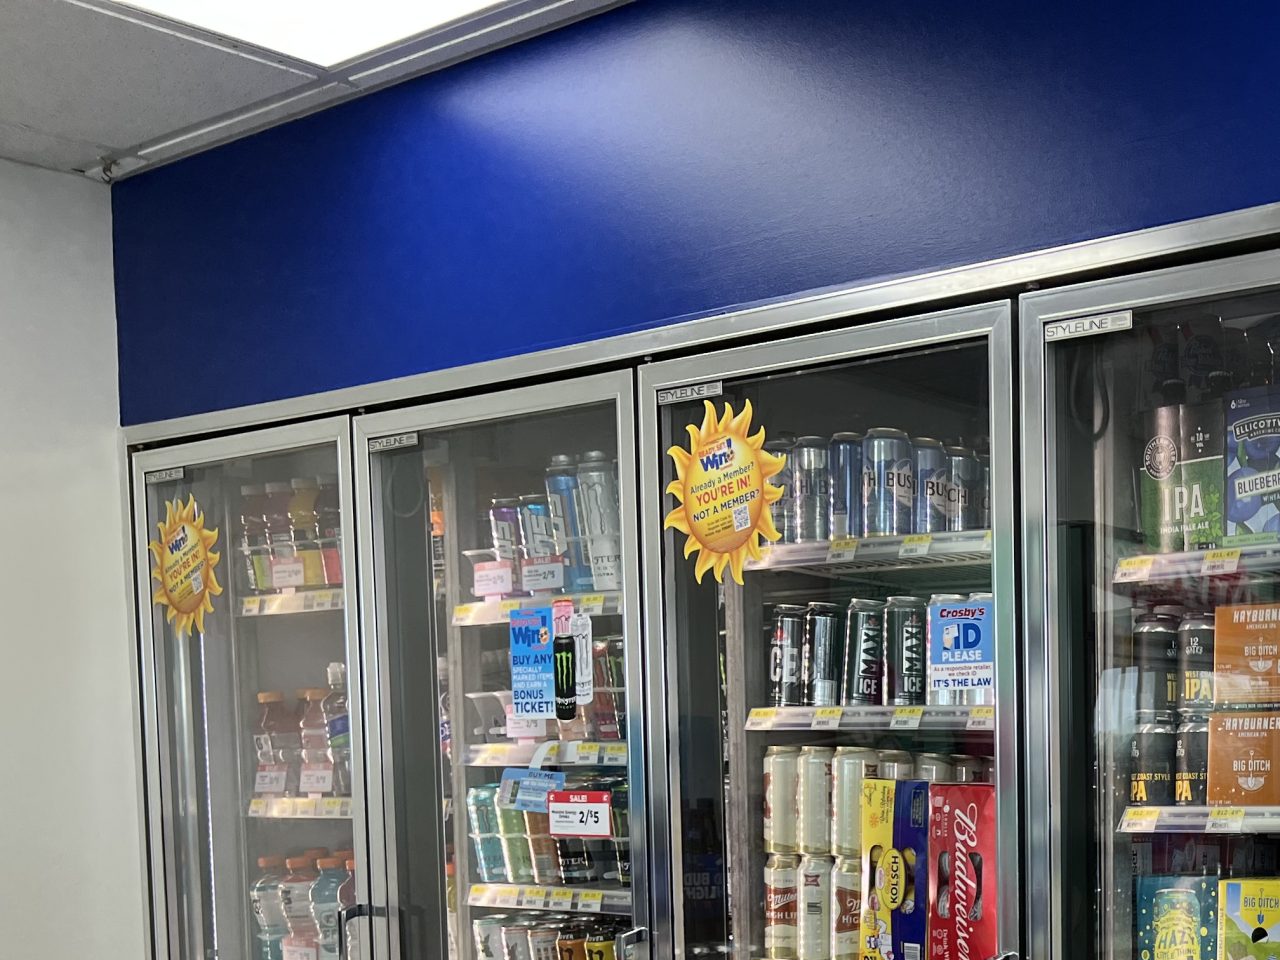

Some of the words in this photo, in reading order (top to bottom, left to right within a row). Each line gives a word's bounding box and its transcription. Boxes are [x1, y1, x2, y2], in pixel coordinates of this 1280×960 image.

[1046, 318, 1109, 337] STYLELINE
[659, 385, 704, 403] STYLELINE
[690, 480, 715, 495] Already
[723, 462, 755, 481] Member?
[696, 482, 734, 506] YOU'RE
[737, 476, 750, 491] IN!
[693, 510, 709, 522] NOT
[712, 506, 719, 514] A
[721, 489, 760, 512] MEMBER?
[1163, 484, 1205, 522] IPA
[939, 607, 985, 619] Crosby's
[861, 629, 880, 675] MAX
[904, 627, 922, 673] MAX
[942, 650, 982, 662] PLEASE
[1244, 646, 1257, 656] BIG
[1258, 645, 1278, 656] DITCH
[512, 655, 531, 665] BUY
[534, 654, 552, 664] ANY
[859, 677, 878, 695] ICE
[904, 676, 922, 693] ICE
[933, 678, 949, 688] IT'S
[951, 678, 969, 687] THE
[971, 677, 992, 686] LAW
[514, 690, 544, 699] BONUS
[514, 702, 553, 713] TICKET!
[1233, 760, 1247, 771] BIG
[1248, 760, 1271, 771] DITCH
[890, 855, 899, 904] KOLSCH
[1243, 897, 1257, 908] BIG
[1258, 898, 1280, 909] DITCH
